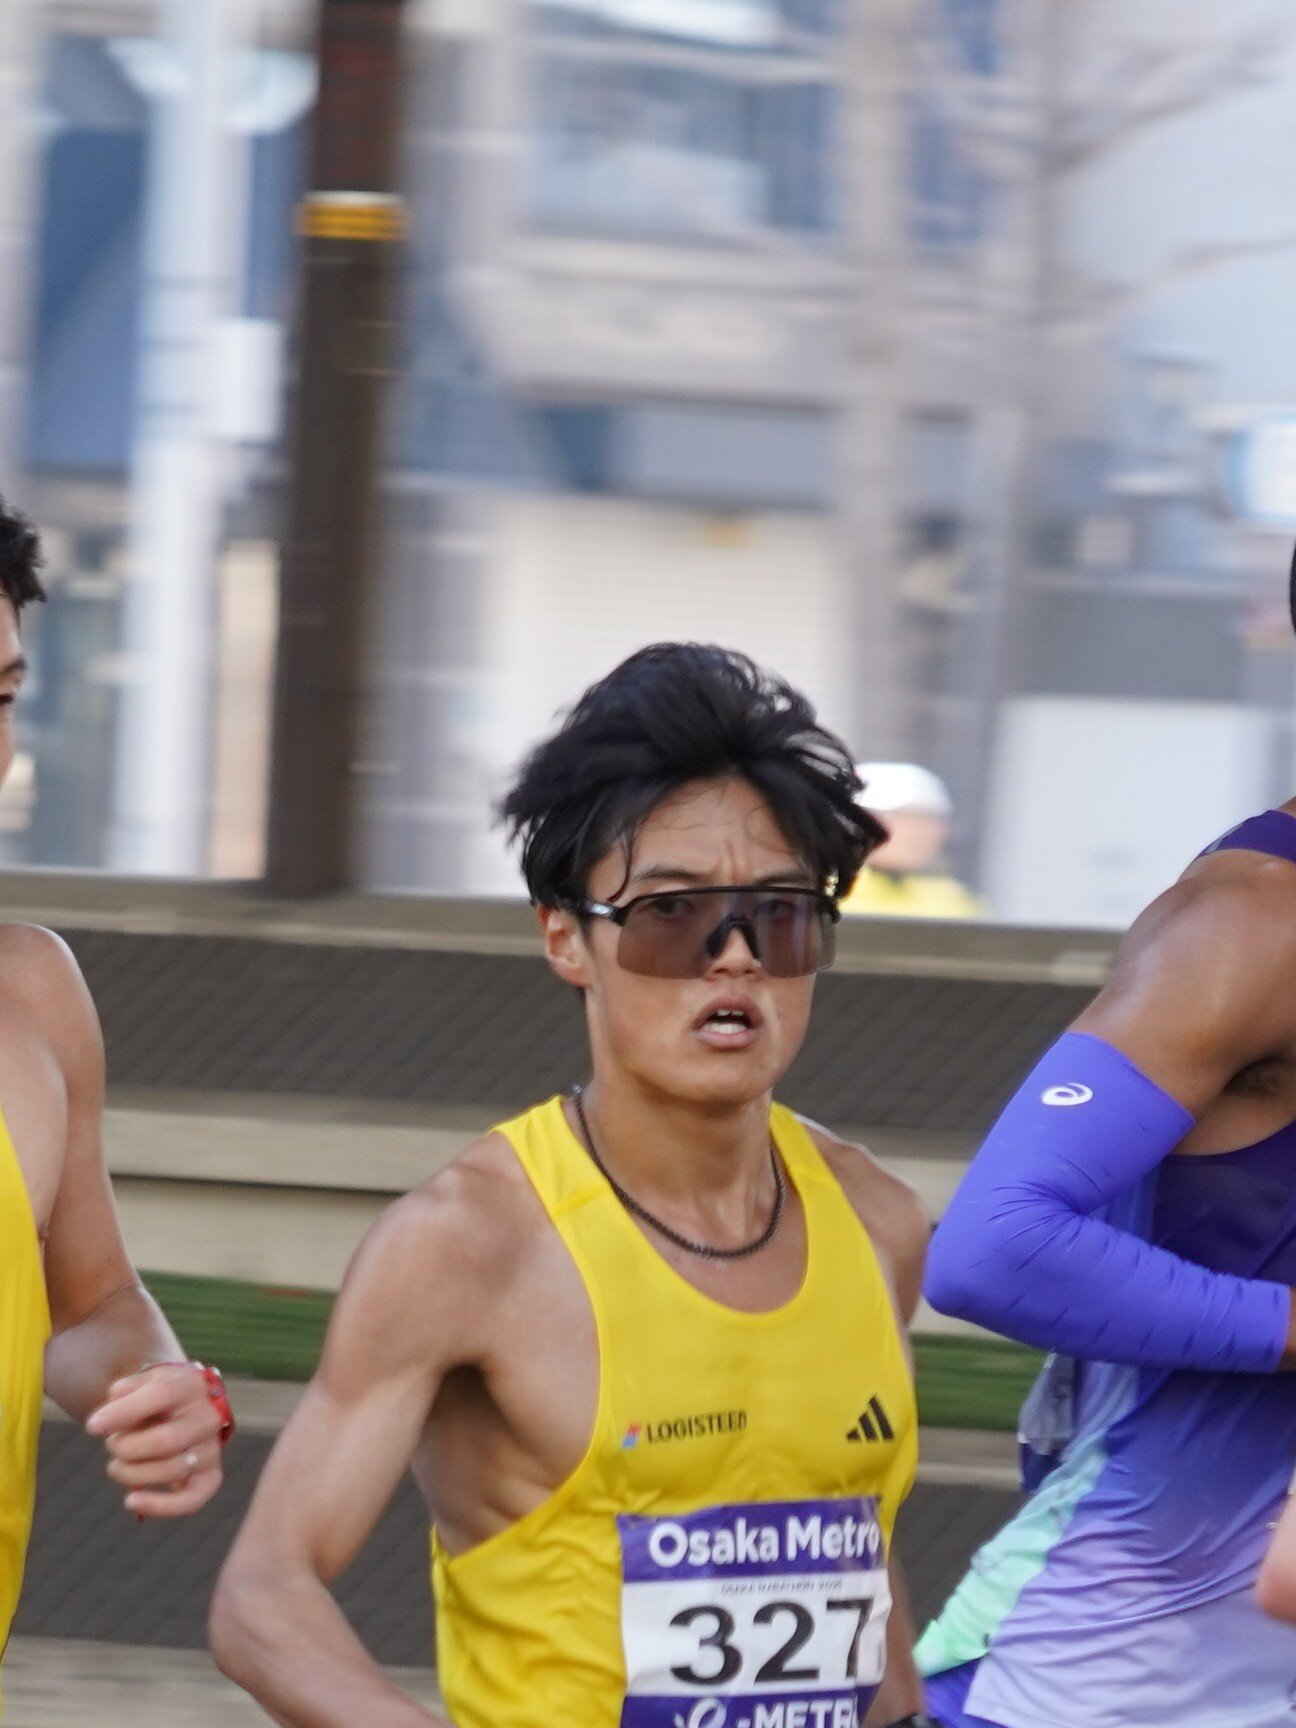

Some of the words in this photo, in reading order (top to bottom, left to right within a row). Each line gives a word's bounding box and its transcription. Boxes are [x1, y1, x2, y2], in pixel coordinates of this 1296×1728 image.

[646, 1410, 748, 1444] LOGISTEED
[649, 1518, 780, 1567] Osaka
[786, 1515, 879, 1561] Metro
[669, 1597, 874, 1686] 327
